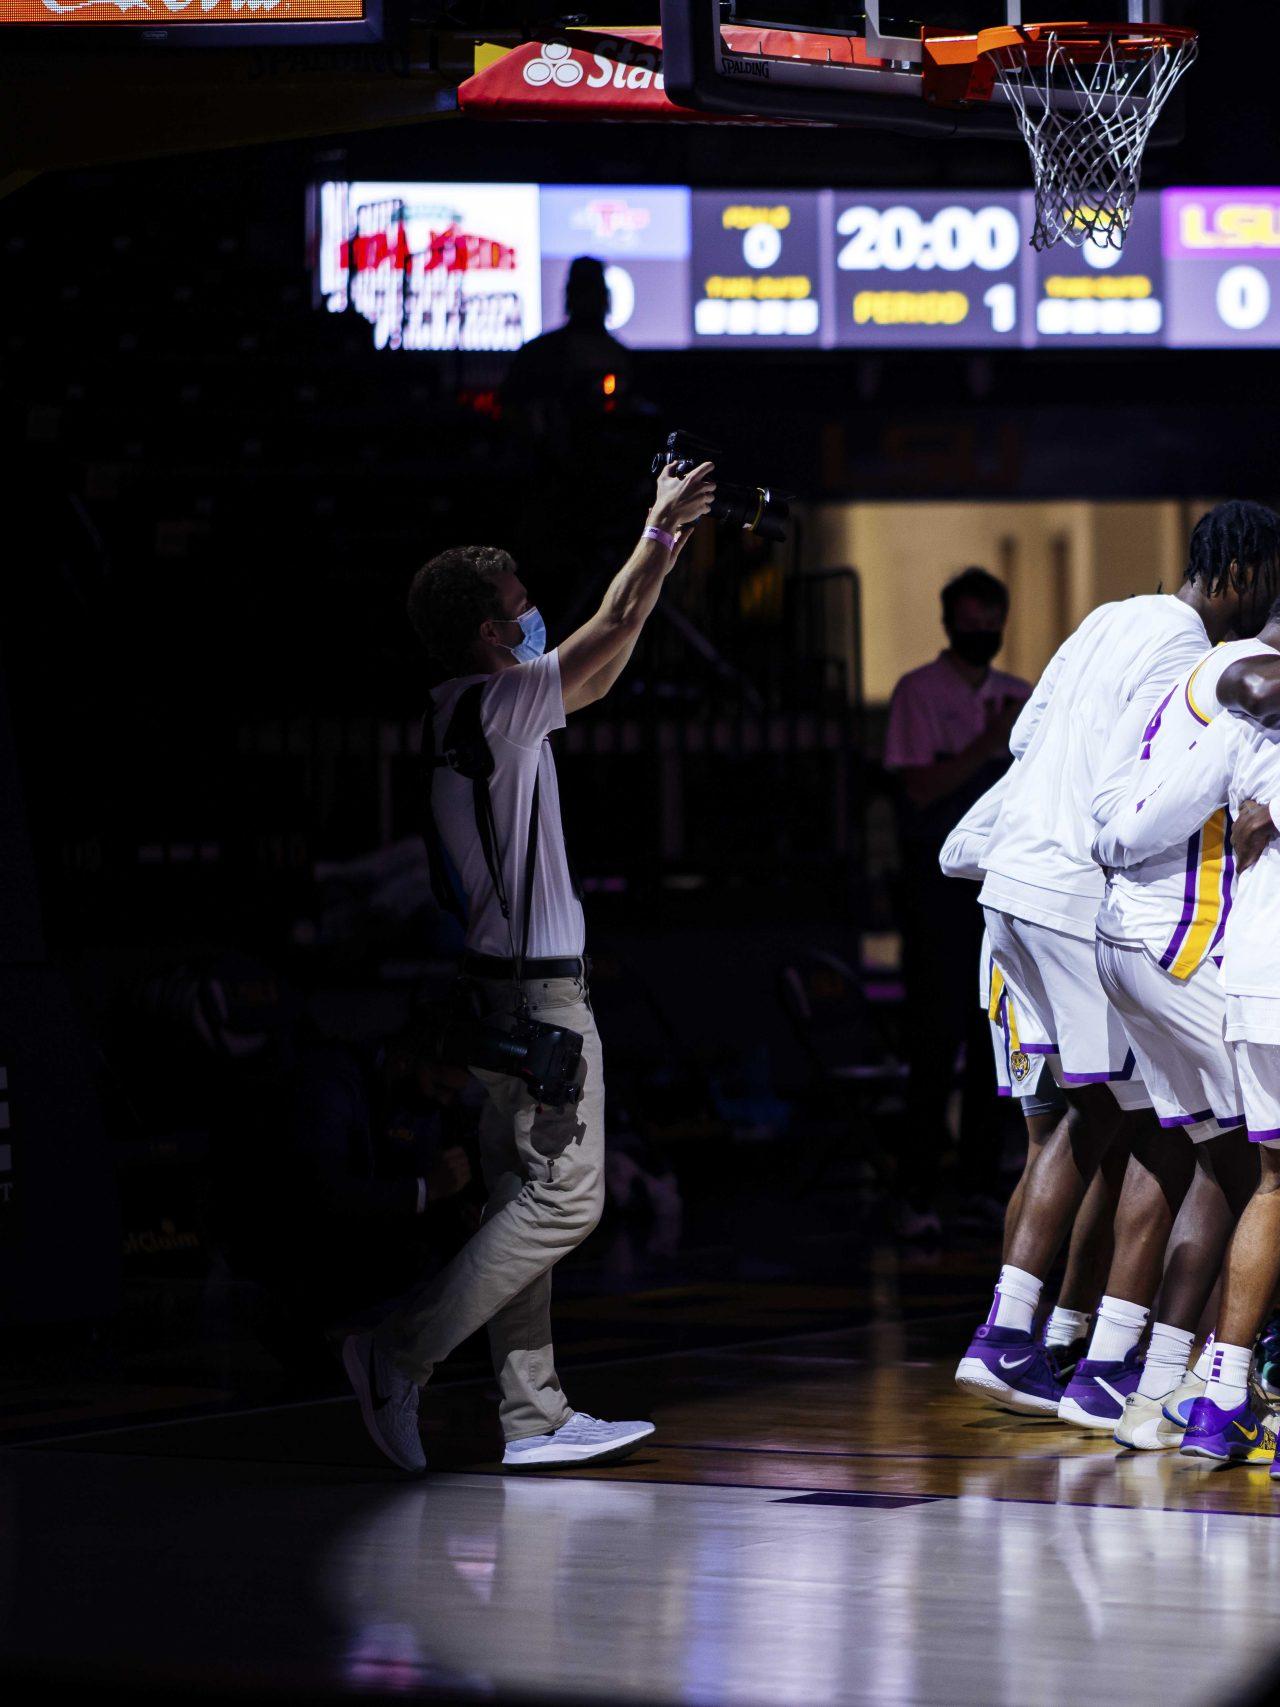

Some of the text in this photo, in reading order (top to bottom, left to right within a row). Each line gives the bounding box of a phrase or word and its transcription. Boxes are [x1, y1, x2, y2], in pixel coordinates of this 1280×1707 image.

[721, 56, 769, 78] SPALDING
[743, 223, 781, 269] 0
[837, 206, 1019, 271] 20:00
[984, 283, 1016, 333] 1
[1217, 265, 1270, 330] 0
